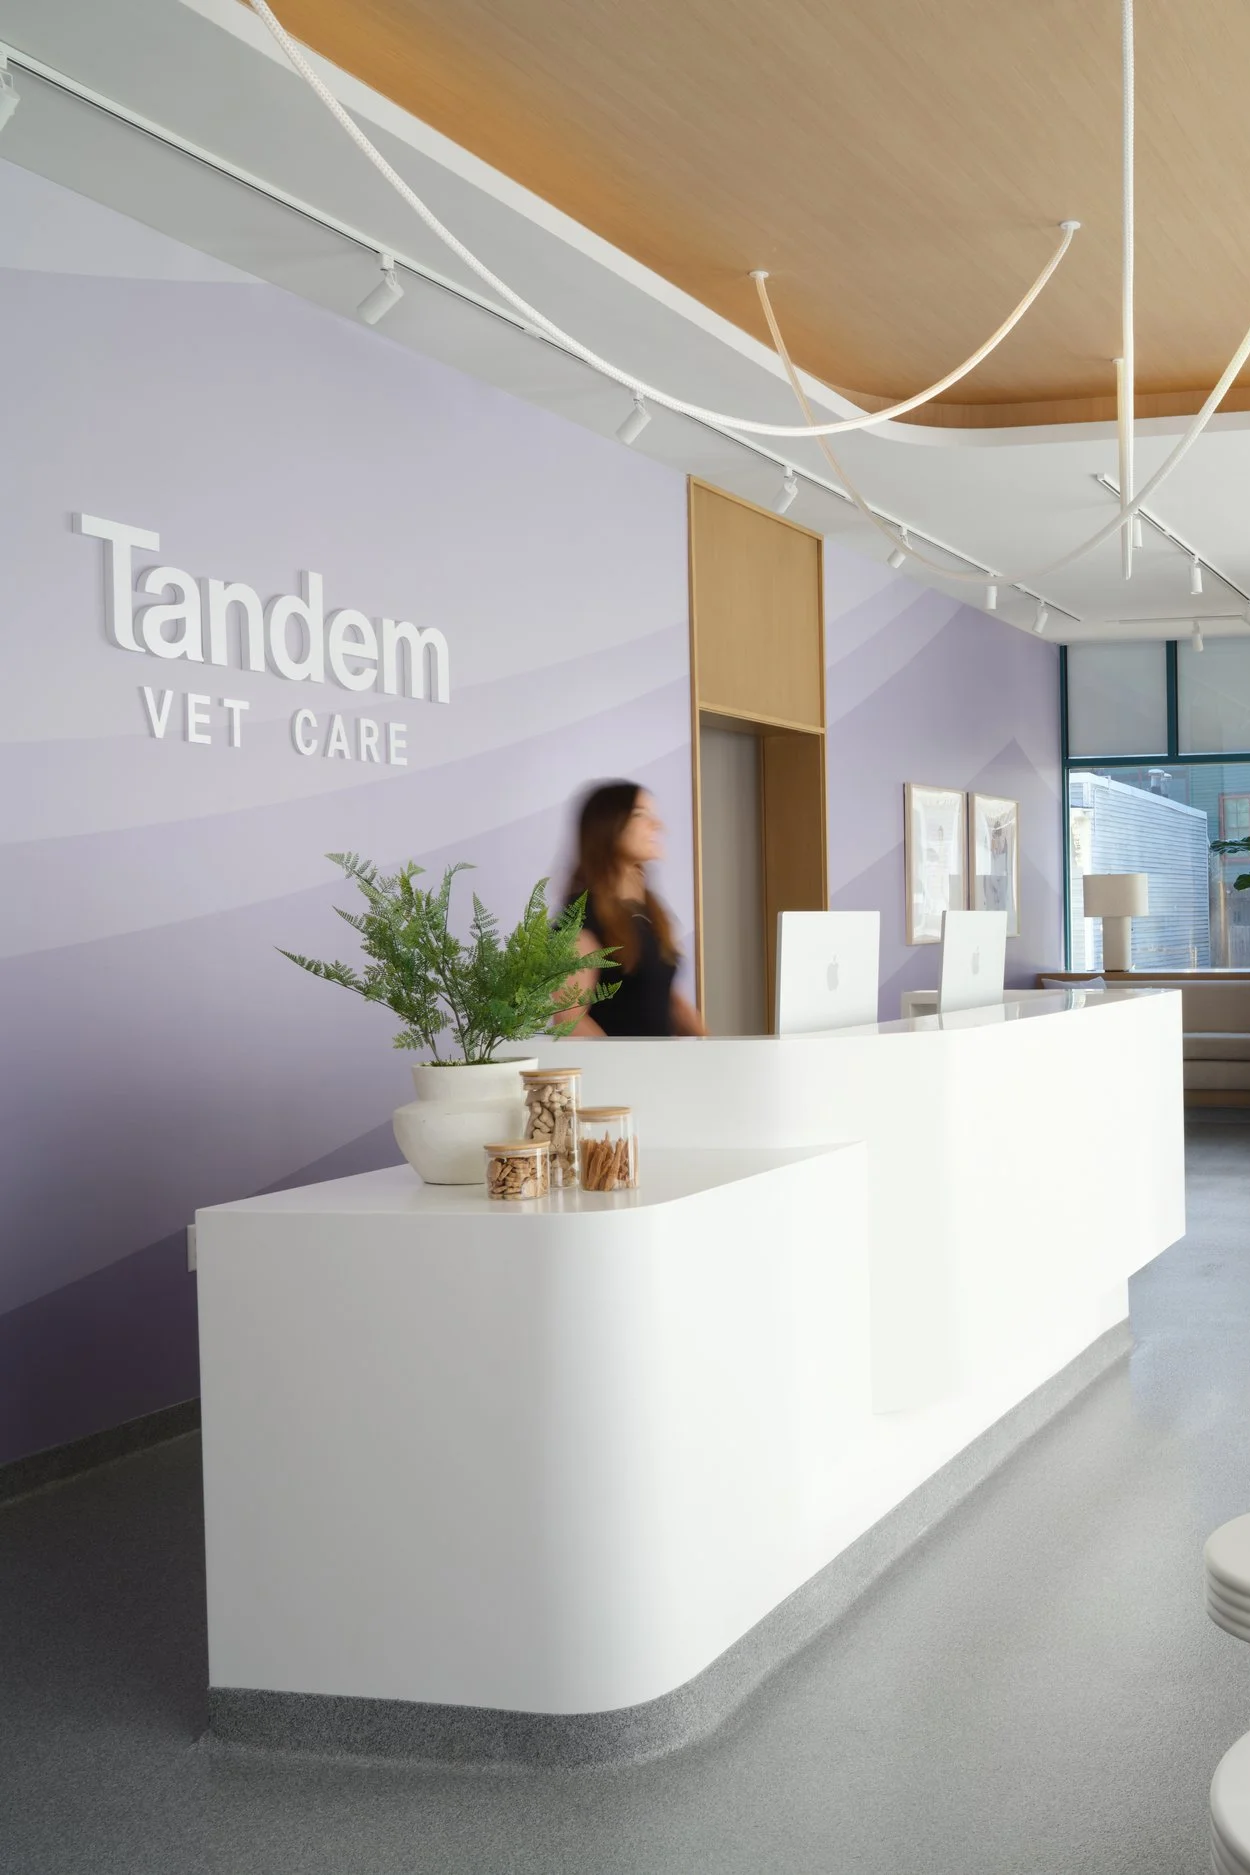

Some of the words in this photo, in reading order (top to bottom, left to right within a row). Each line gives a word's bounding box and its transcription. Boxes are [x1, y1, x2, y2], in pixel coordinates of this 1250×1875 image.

[73, 512, 450, 704] Tandem
[142, 685, 250, 748] VET
[291, 708, 409, 766] CARE
